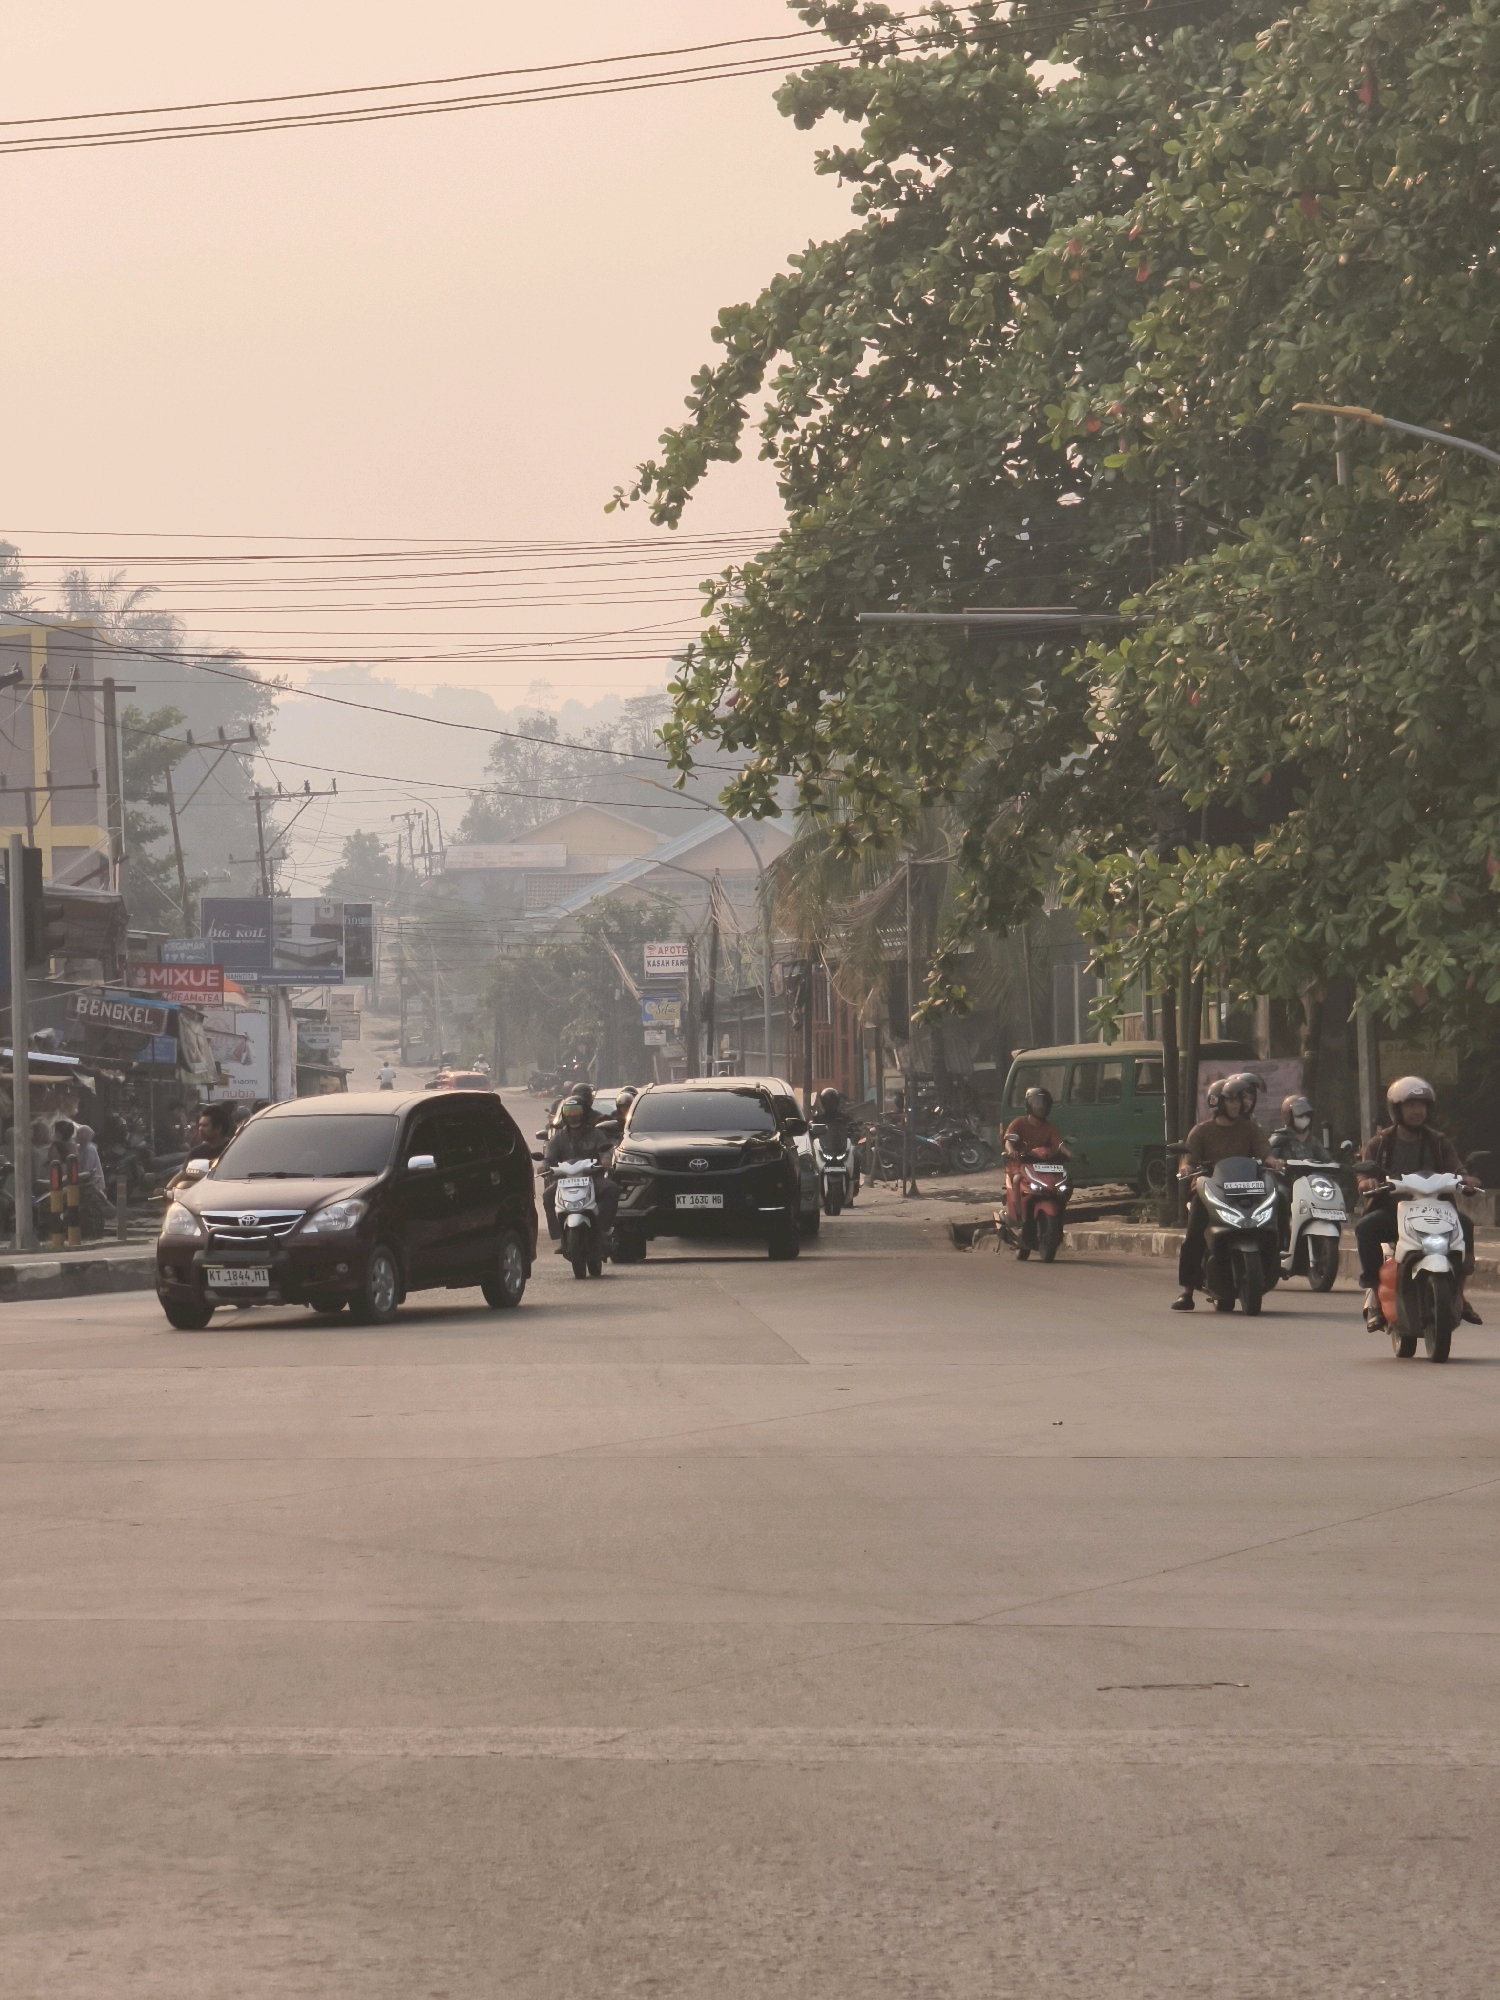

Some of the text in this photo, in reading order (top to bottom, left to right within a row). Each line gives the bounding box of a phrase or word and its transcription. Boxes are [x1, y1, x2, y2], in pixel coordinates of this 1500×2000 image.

[236, 928, 266, 938] KOIL
[658, 946, 688, 954] APOTE
[150, 969, 219, 986] MIXUE
[76, 998, 153, 1024] BENGKEL
[223, 1089, 255, 1098] nubia
[677, 1196, 686, 1204] KT
[209, 1271, 267, 1281] KT 1844 MI
